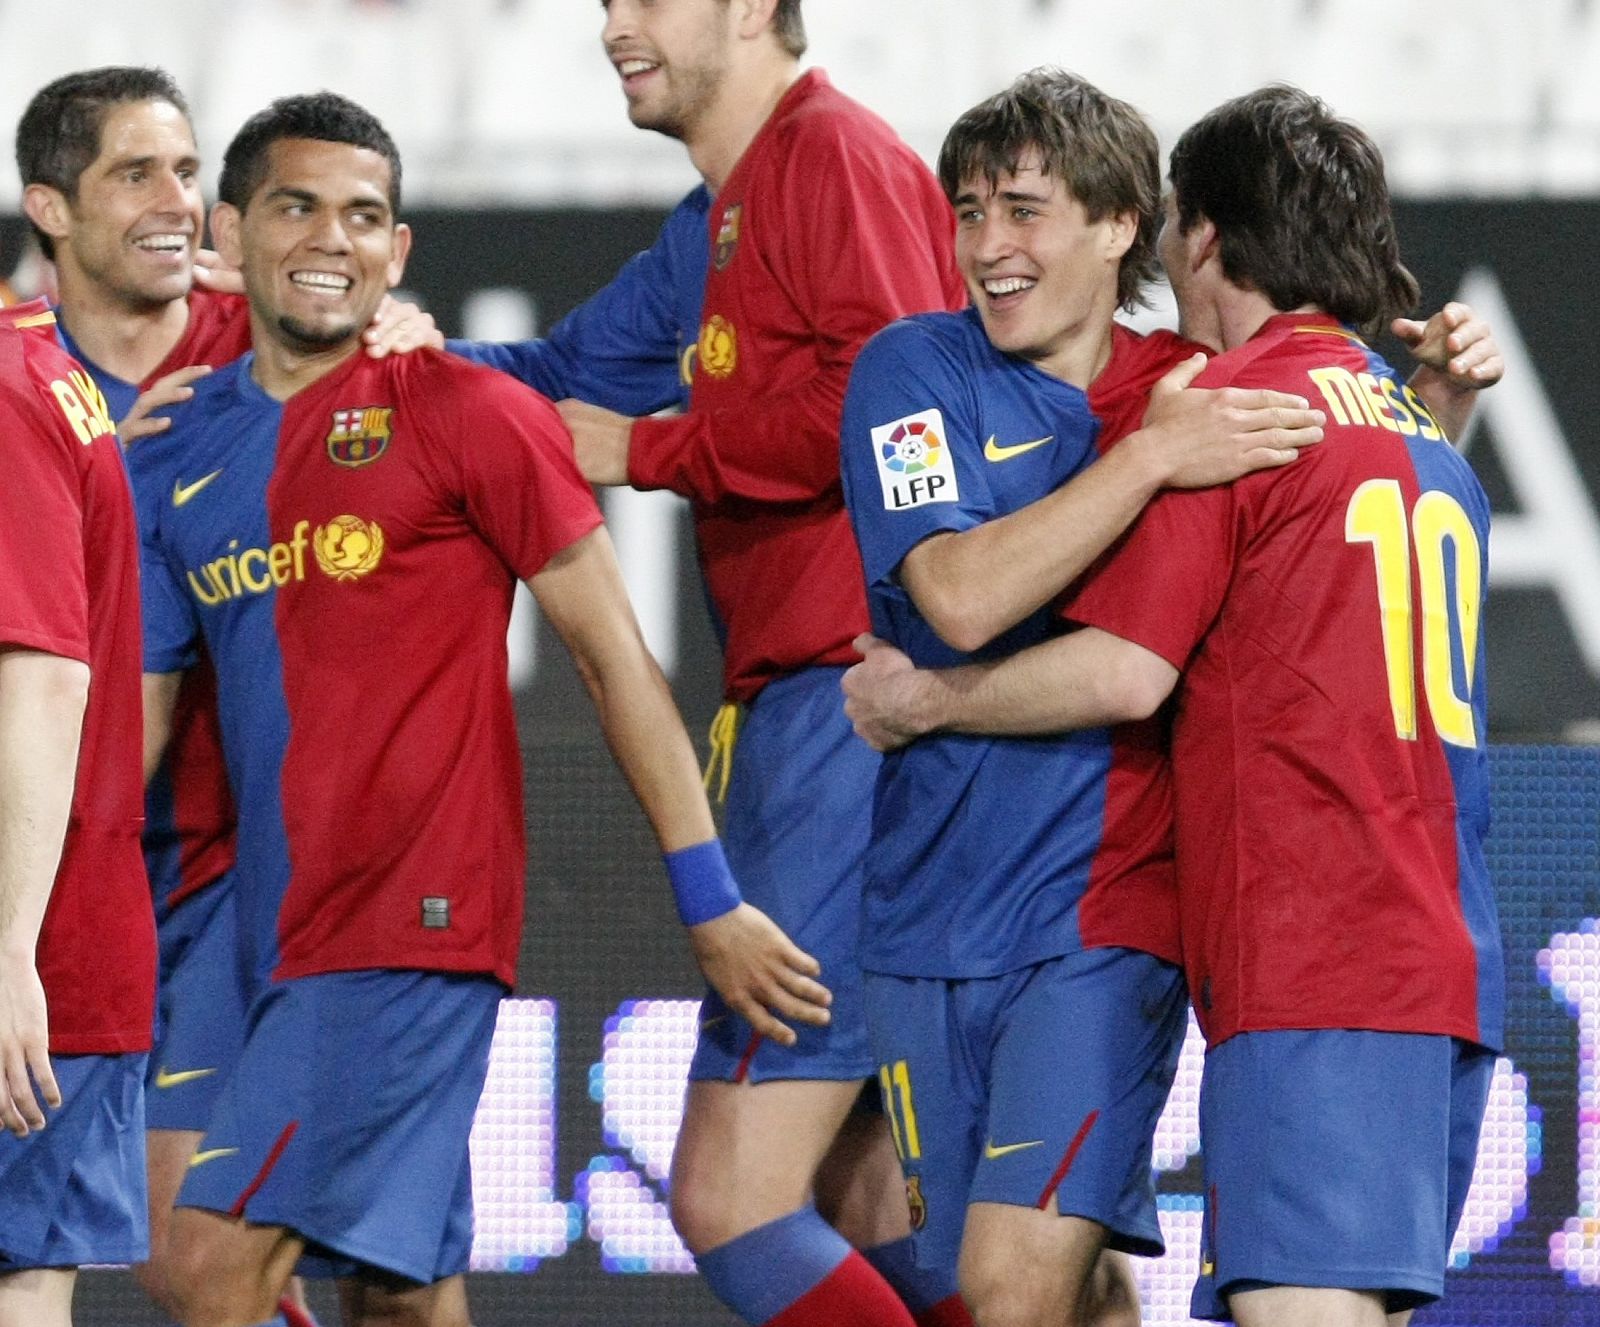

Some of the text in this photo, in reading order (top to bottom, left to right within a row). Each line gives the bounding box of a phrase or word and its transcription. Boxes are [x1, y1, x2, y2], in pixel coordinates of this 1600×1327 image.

[1306, 365, 1452, 447] MESS
[891, 473, 946, 508] LFP
[186, 519, 310, 607] unicef
[1344, 477, 1481, 748] 10
